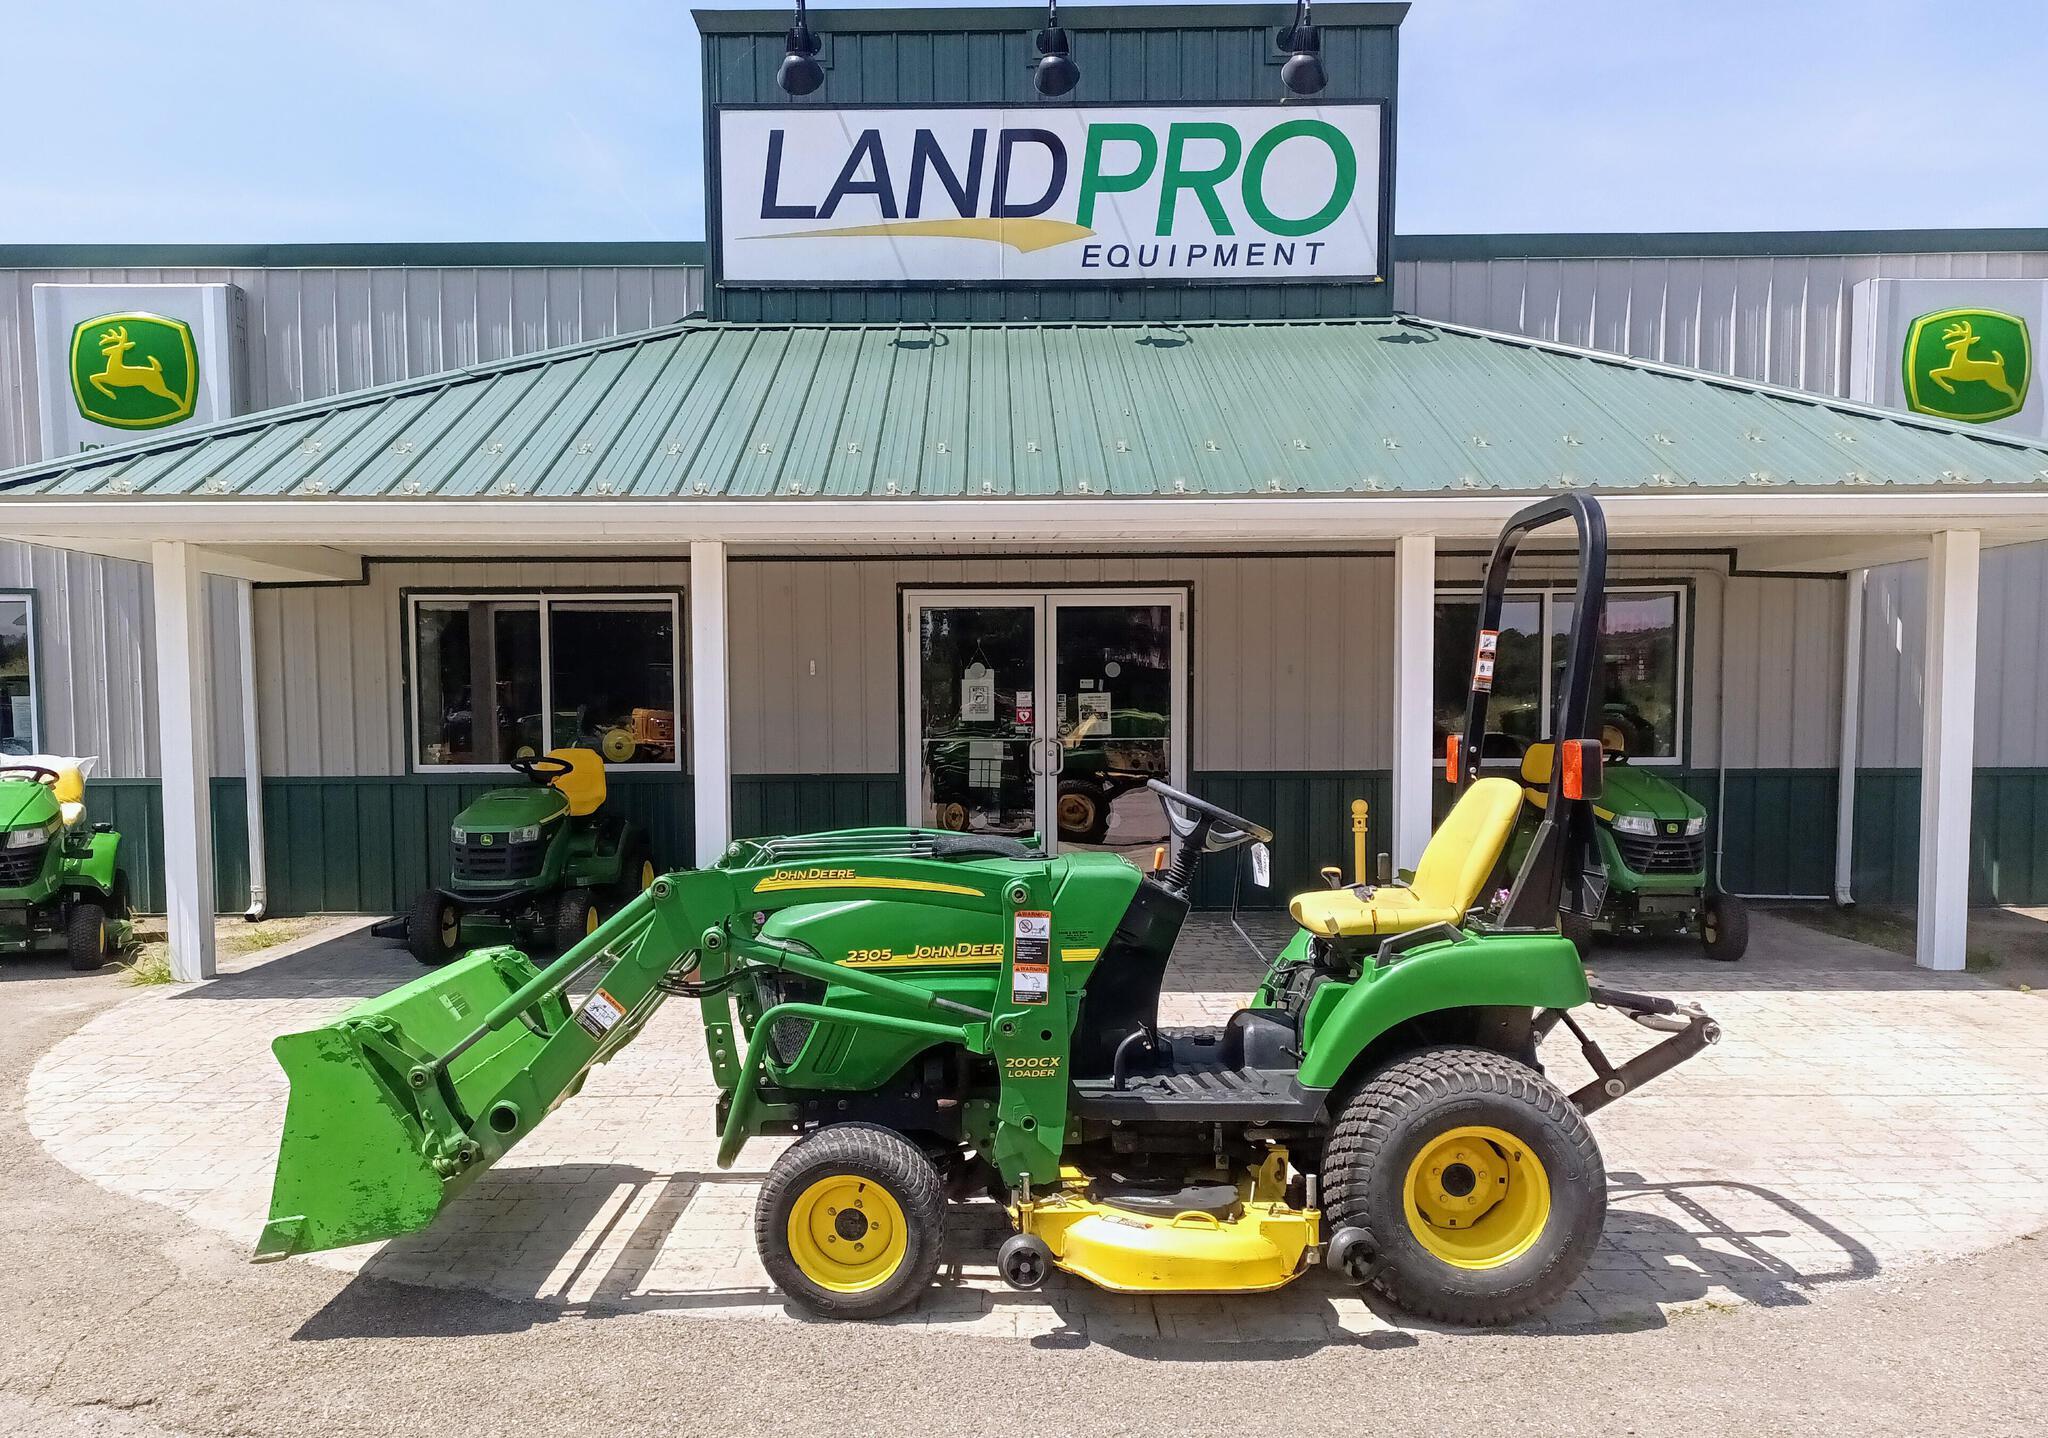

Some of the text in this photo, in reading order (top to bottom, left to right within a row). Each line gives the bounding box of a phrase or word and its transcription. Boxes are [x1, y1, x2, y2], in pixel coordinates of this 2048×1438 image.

[760, 119, 1357, 237] LANDPRO
[1081, 242, 1325, 268] EQUIPMENT
[769, 868, 856, 880] JOHN DEERE
[846, 949, 892, 962] 2305
[907, 944, 955, 959] JOHN
[956, 943, 1004, 957] DEER
[1004, 1056, 1062, 1068] 200CX
[1007, 1069, 1056, 1078] LOADER
